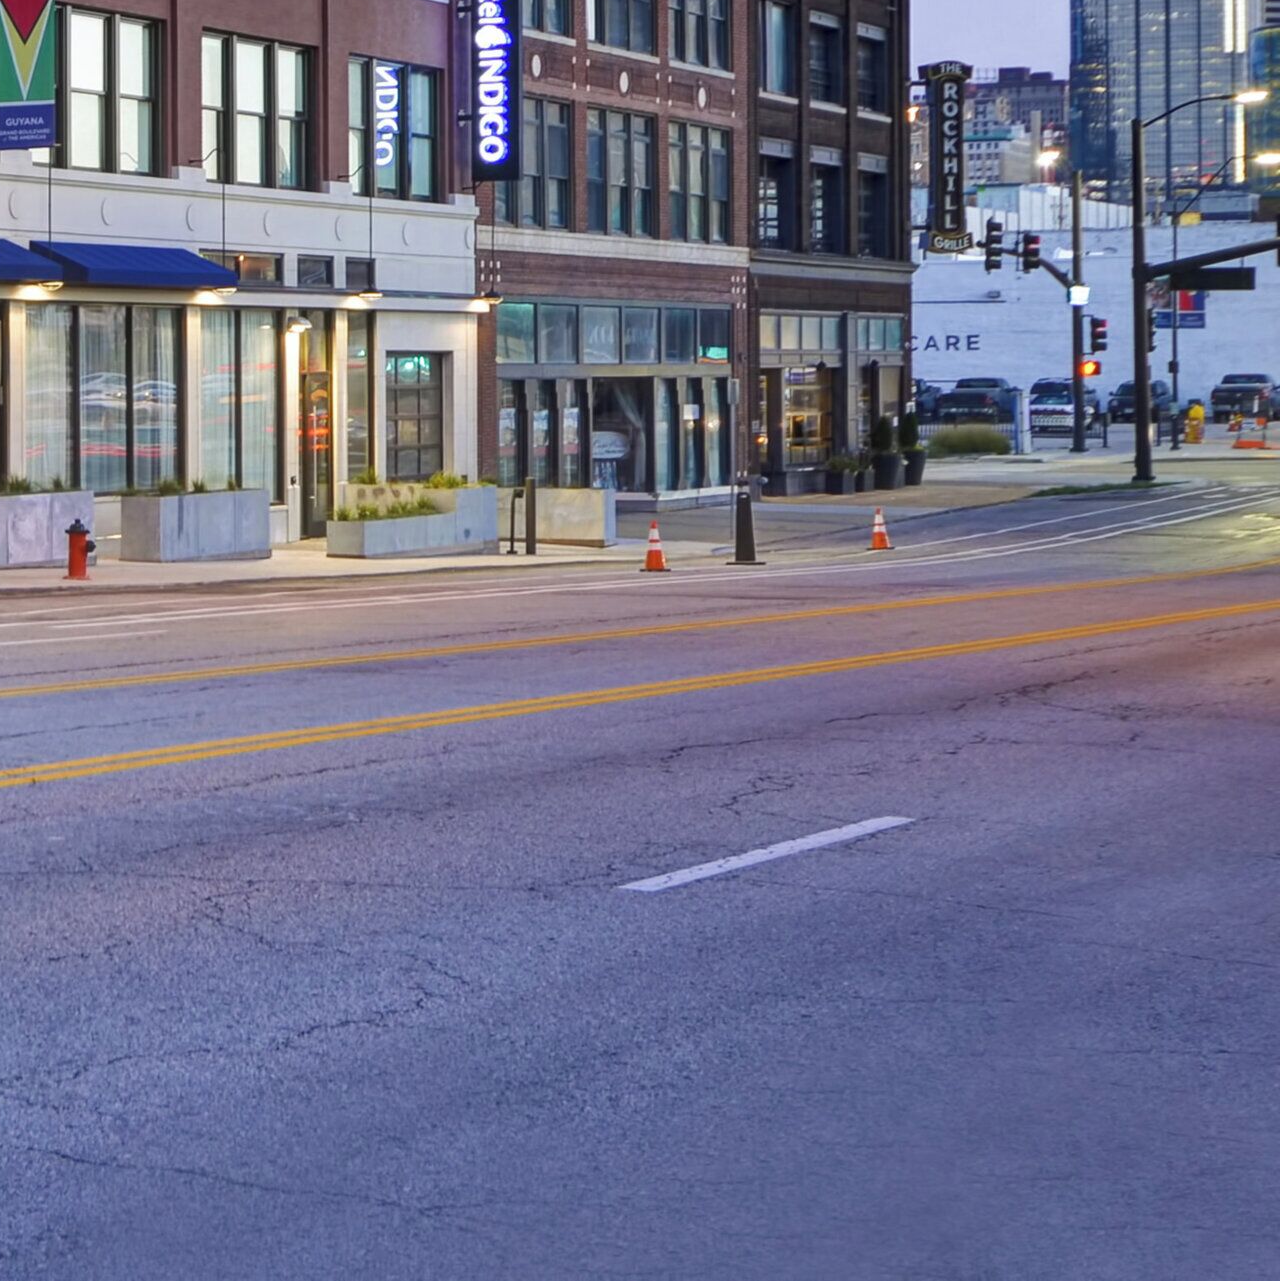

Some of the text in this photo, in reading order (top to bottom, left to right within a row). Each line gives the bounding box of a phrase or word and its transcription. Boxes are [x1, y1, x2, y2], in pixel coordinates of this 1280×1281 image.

[940, 62, 963, 75] THE
[478, 48, 507, 163] INDIGO
[5, 117, 45, 127] GUYANA
[942, 81, 959, 230] ROCKHILL
[933, 235, 971, 252] GRILLE
